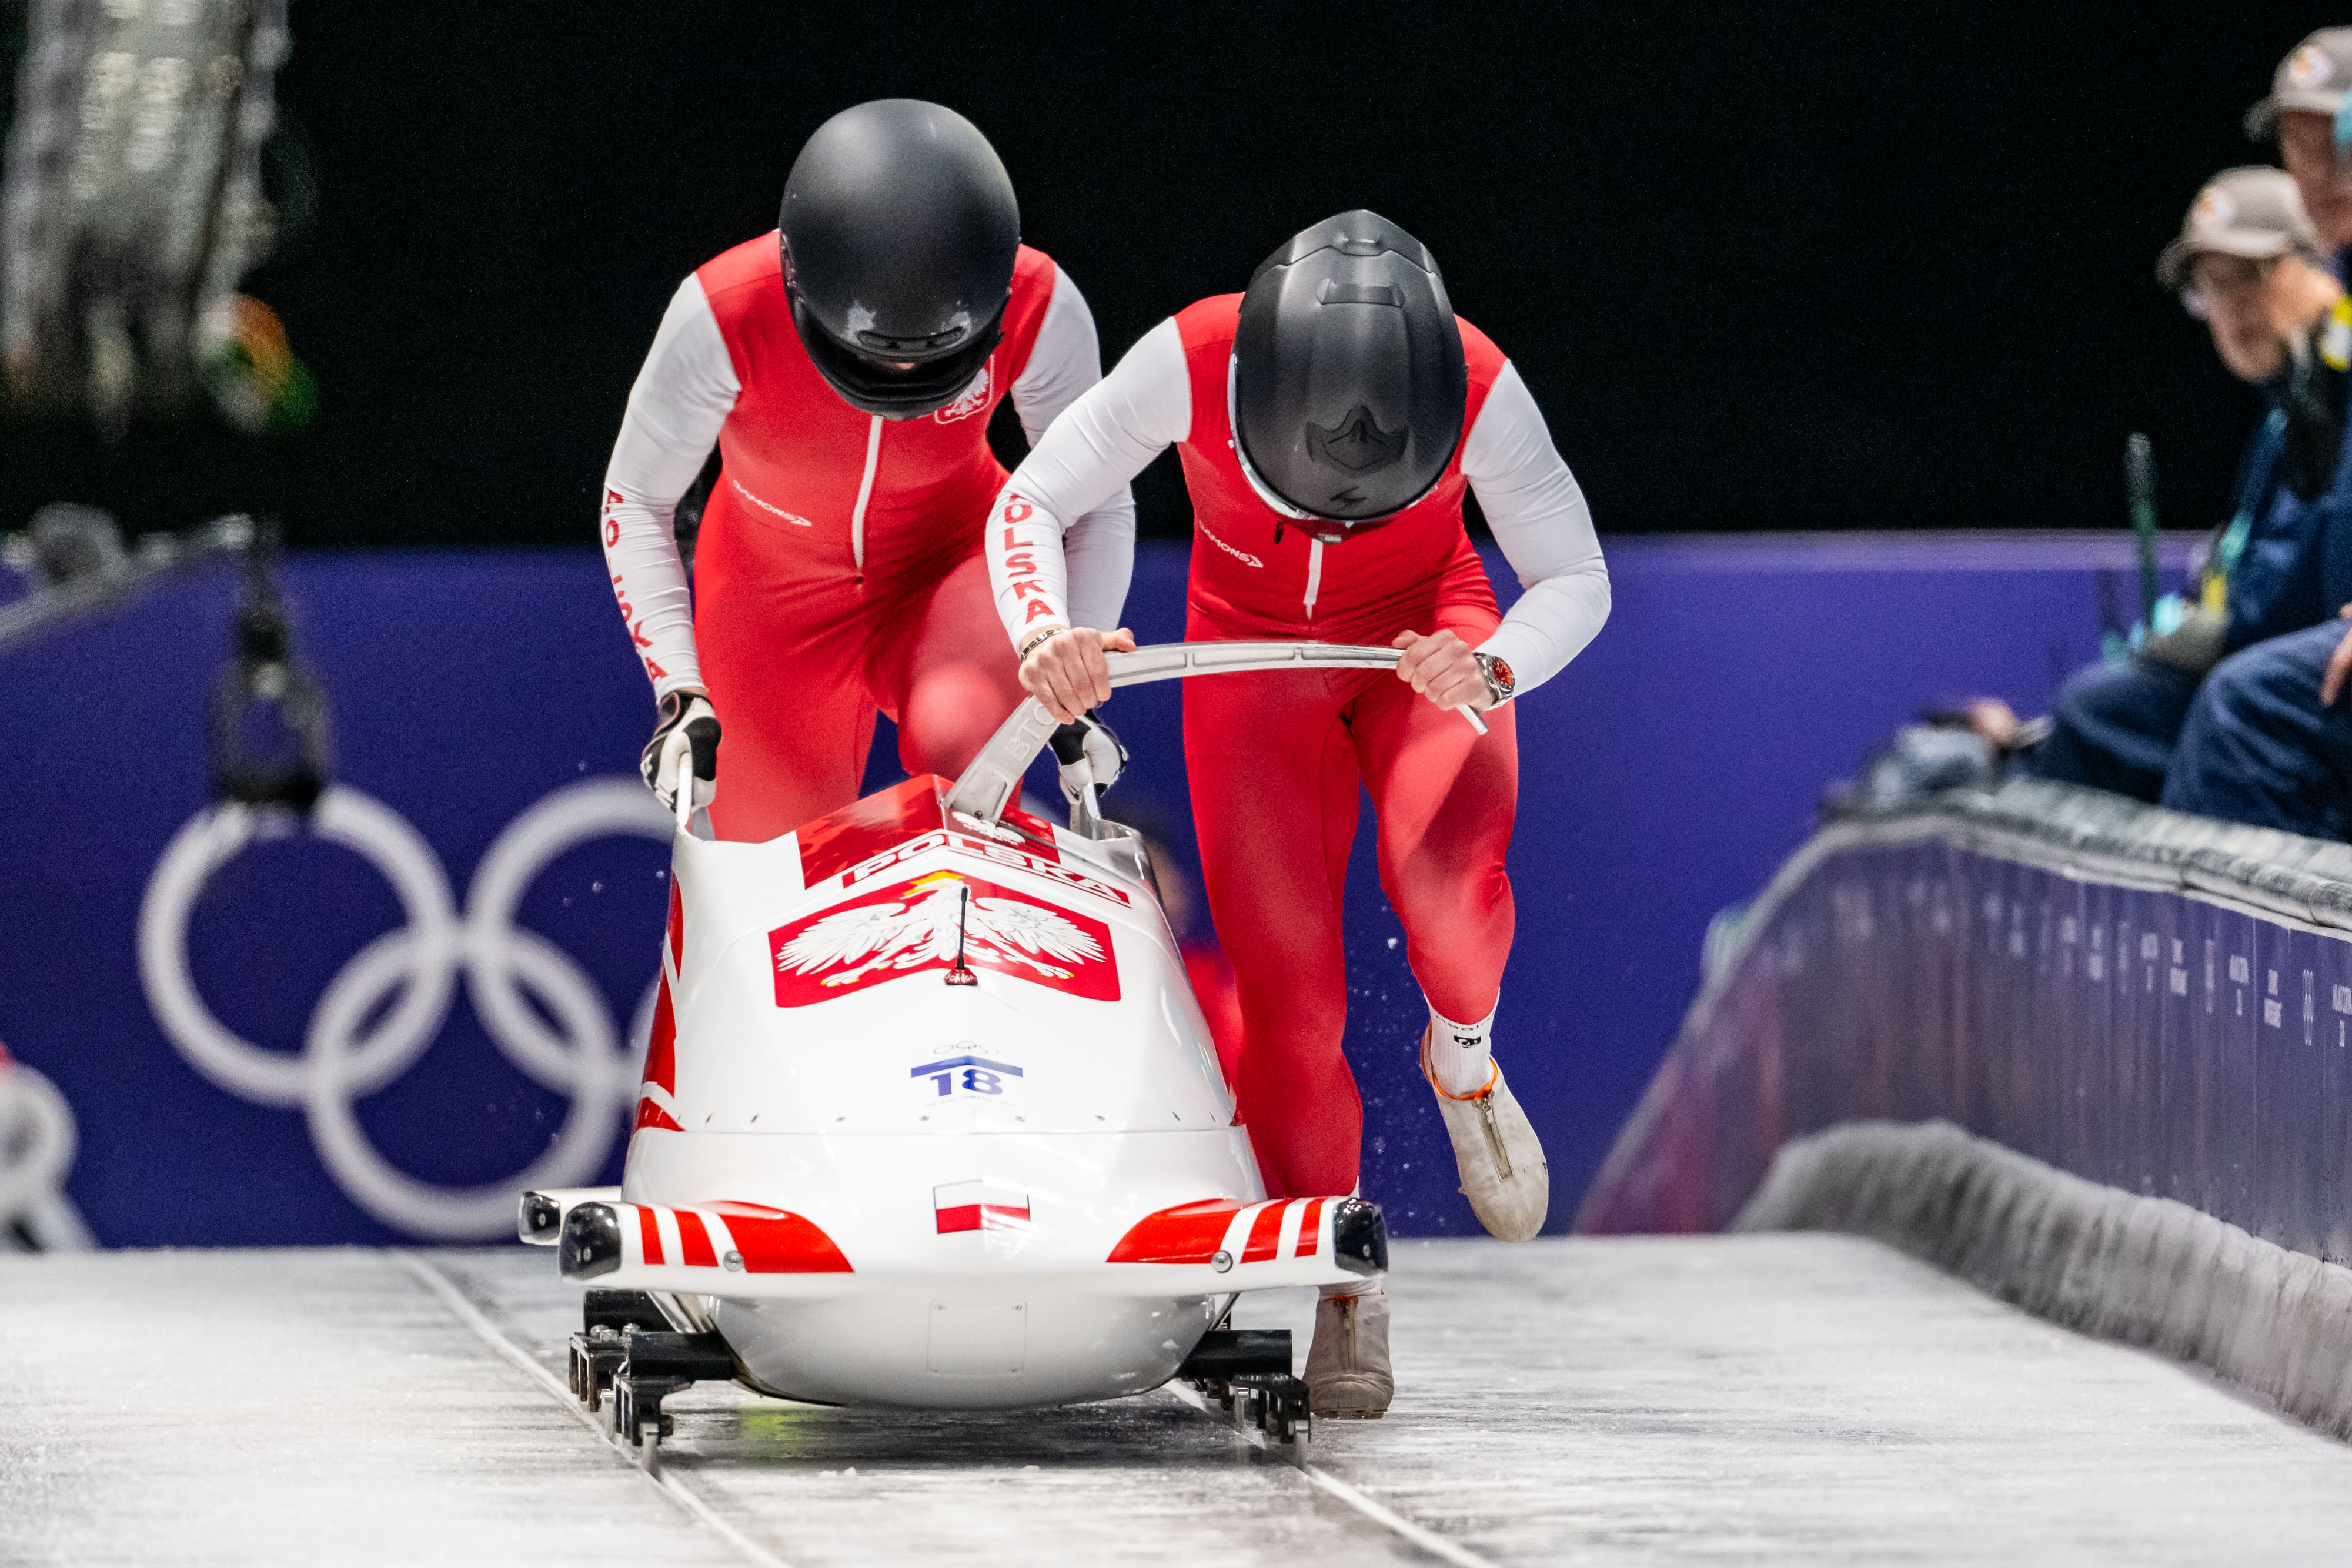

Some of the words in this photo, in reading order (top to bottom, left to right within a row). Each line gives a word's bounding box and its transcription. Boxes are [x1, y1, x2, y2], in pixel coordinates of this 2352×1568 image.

[1004, 494, 1056, 625] OLSKA
[854, 835, 1122, 901] POLSKA
[930, 1069, 1003, 1096] 18
